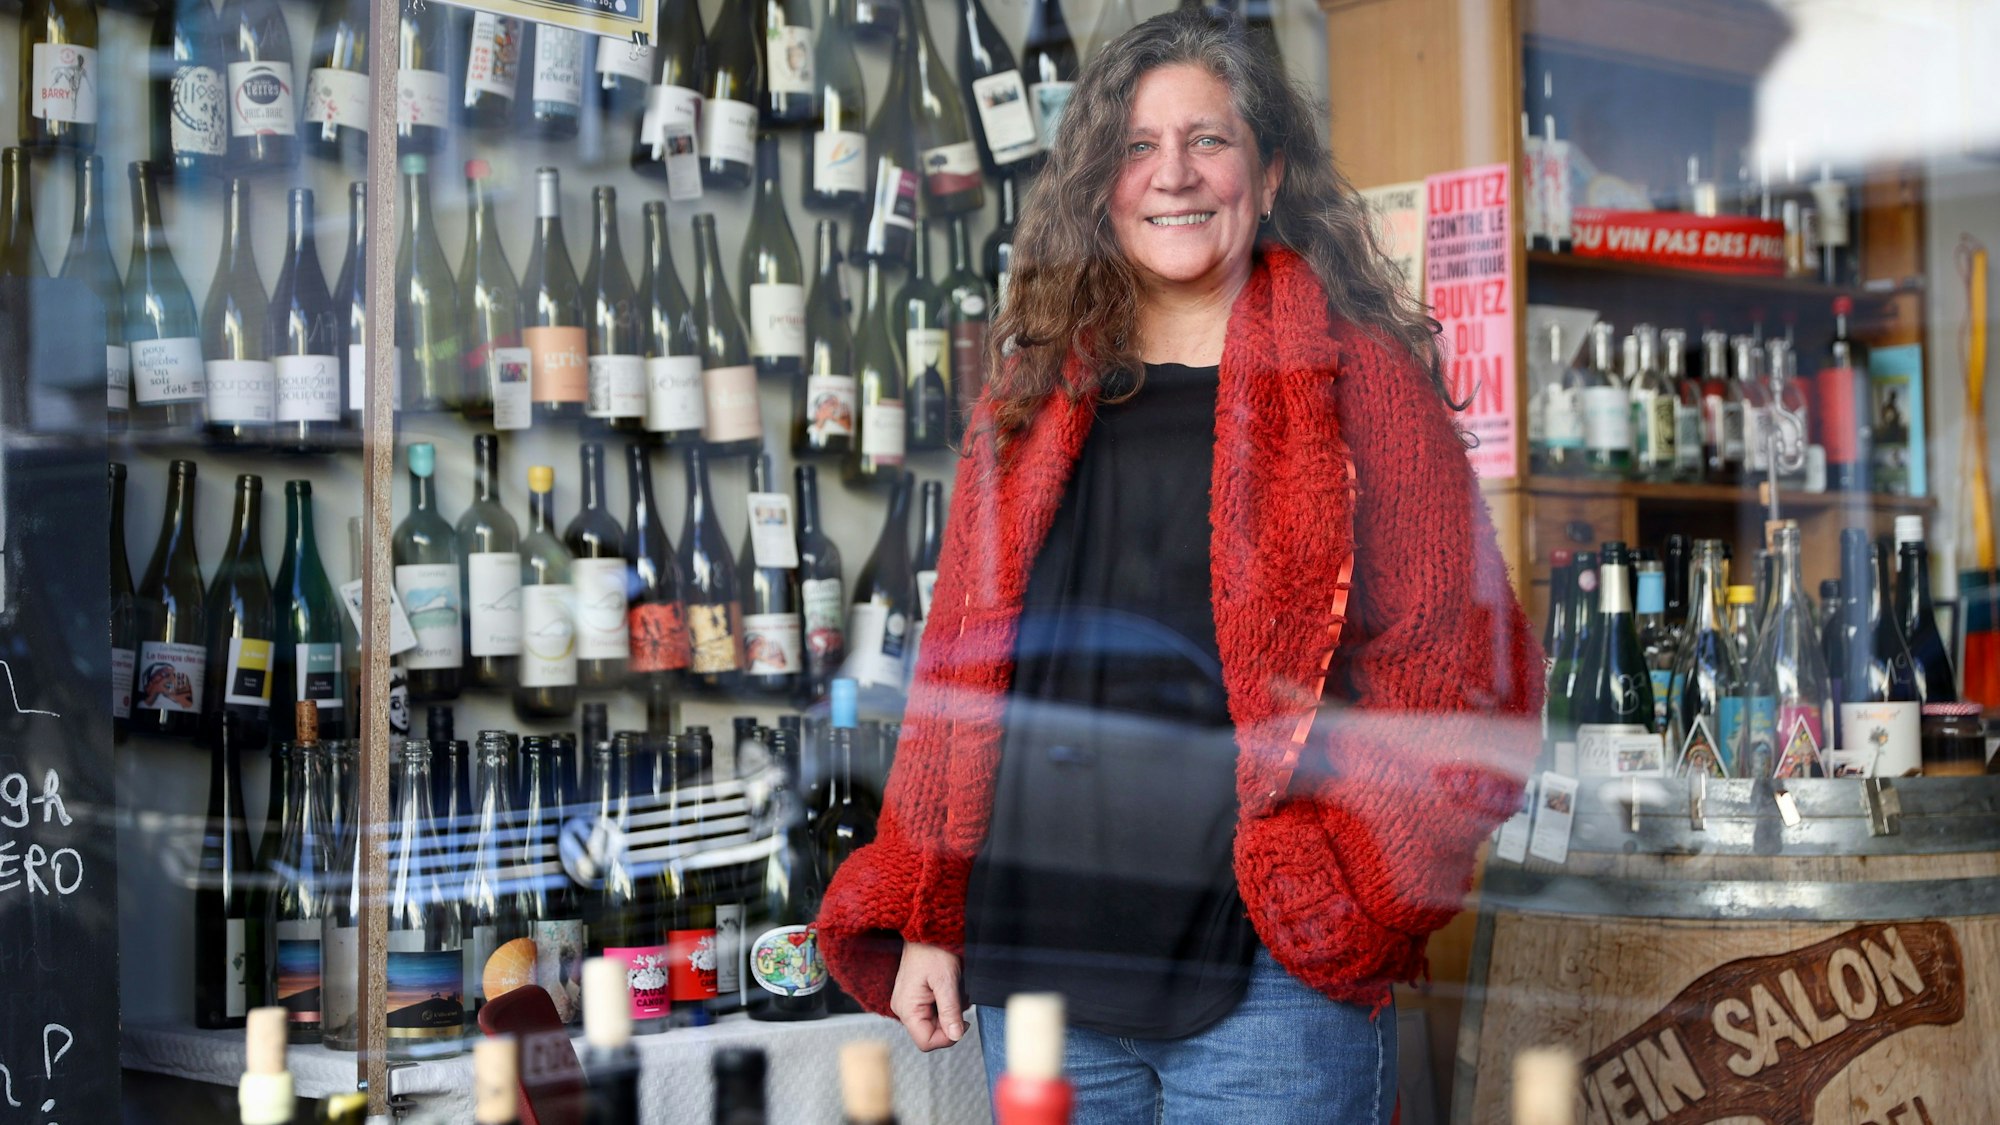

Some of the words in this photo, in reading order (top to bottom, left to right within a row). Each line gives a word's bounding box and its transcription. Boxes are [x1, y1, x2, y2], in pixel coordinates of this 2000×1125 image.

[42, 87, 70, 99] BARRY
[1428, 172, 1505, 215] LUTTEZ
[1430, 212, 1484, 240] CONTRE
[1489, 208, 1504, 232] LE
[1606, 225, 1650, 251] VIN
[1652, 229, 1700, 254] PAS
[1702, 231, 1746, 258] DES
[1431, 255, 1505, 281] CLIMATIQUE
[1434, 279, 1506, 320] BUVEZ
[1456, 322, 1484, 355] DU
[154, 368, 169, 376] un
[544, 346, 584, 373] gris
[150, 377, 169, 385] soir
[1441, 356, 1504, 416] VIN
[157, 652, 182, 665] temps
[1711, 927, 1925, 1077] SALON
